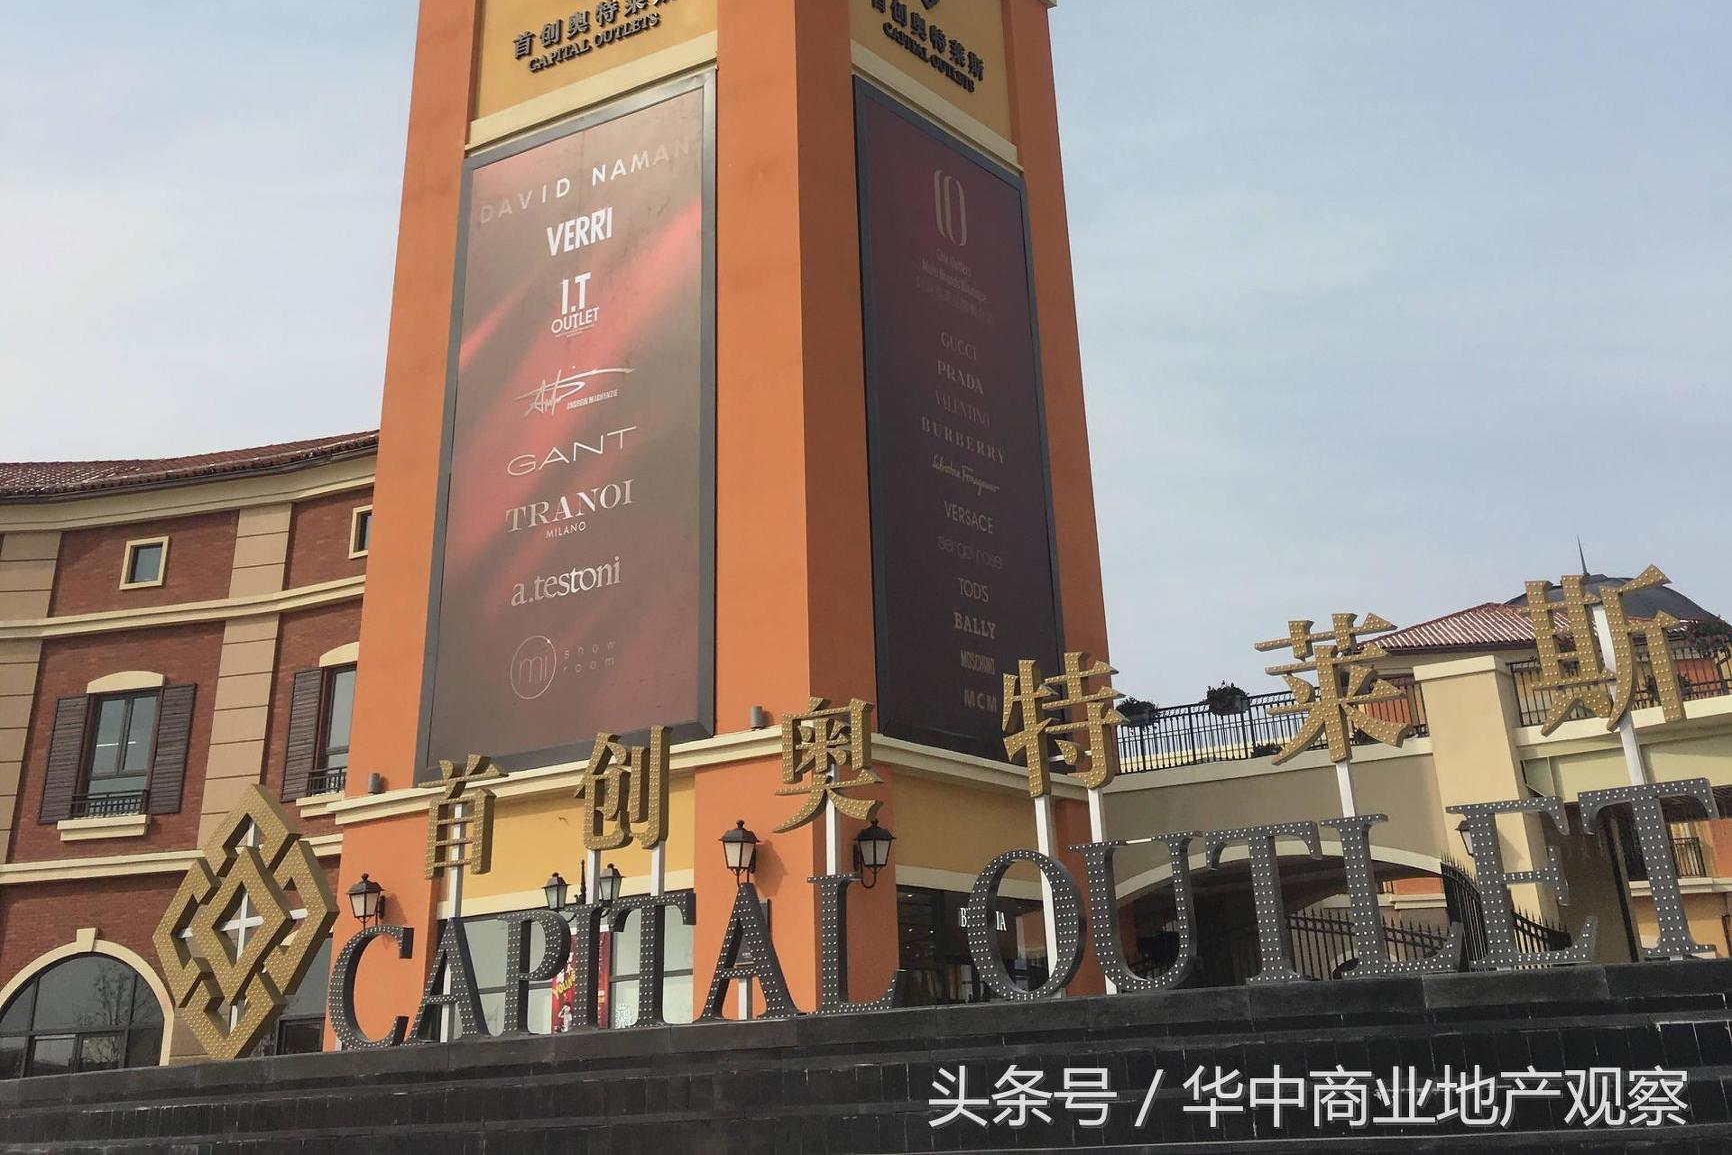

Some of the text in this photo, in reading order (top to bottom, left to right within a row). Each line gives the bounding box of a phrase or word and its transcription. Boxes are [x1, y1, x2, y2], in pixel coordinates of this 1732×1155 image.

[528, 12, 660, 72] CAPITAL OUTLETS
[481, 178, 570, 224] DAVID
[547, 206, 614, 256] VERRI
[561, 272, 592, 315] I.T
[551, 306, 600, 334] OUTLET
[940, 332, 978, 361] GUCCI
[937, 359, 984, 395] PRADA
[507, 426, 638, 476] GANT
[921, 416, 1006, 464] BURBERRY
[505, 479, 635, 534] TRANOI
[944, 500, 994, 535] VERSACE
[545, 521, 587, 540] MILANO
[511, 555, 622, 607] a.testoni
[953, 612, 997, 639] BALLY
[419, 565, 1686, 880] 首创奥特莱斯
[964, 689, 998, 712] MCM
[329, 777, 1720, 1050] CAPITAL OUTLET
